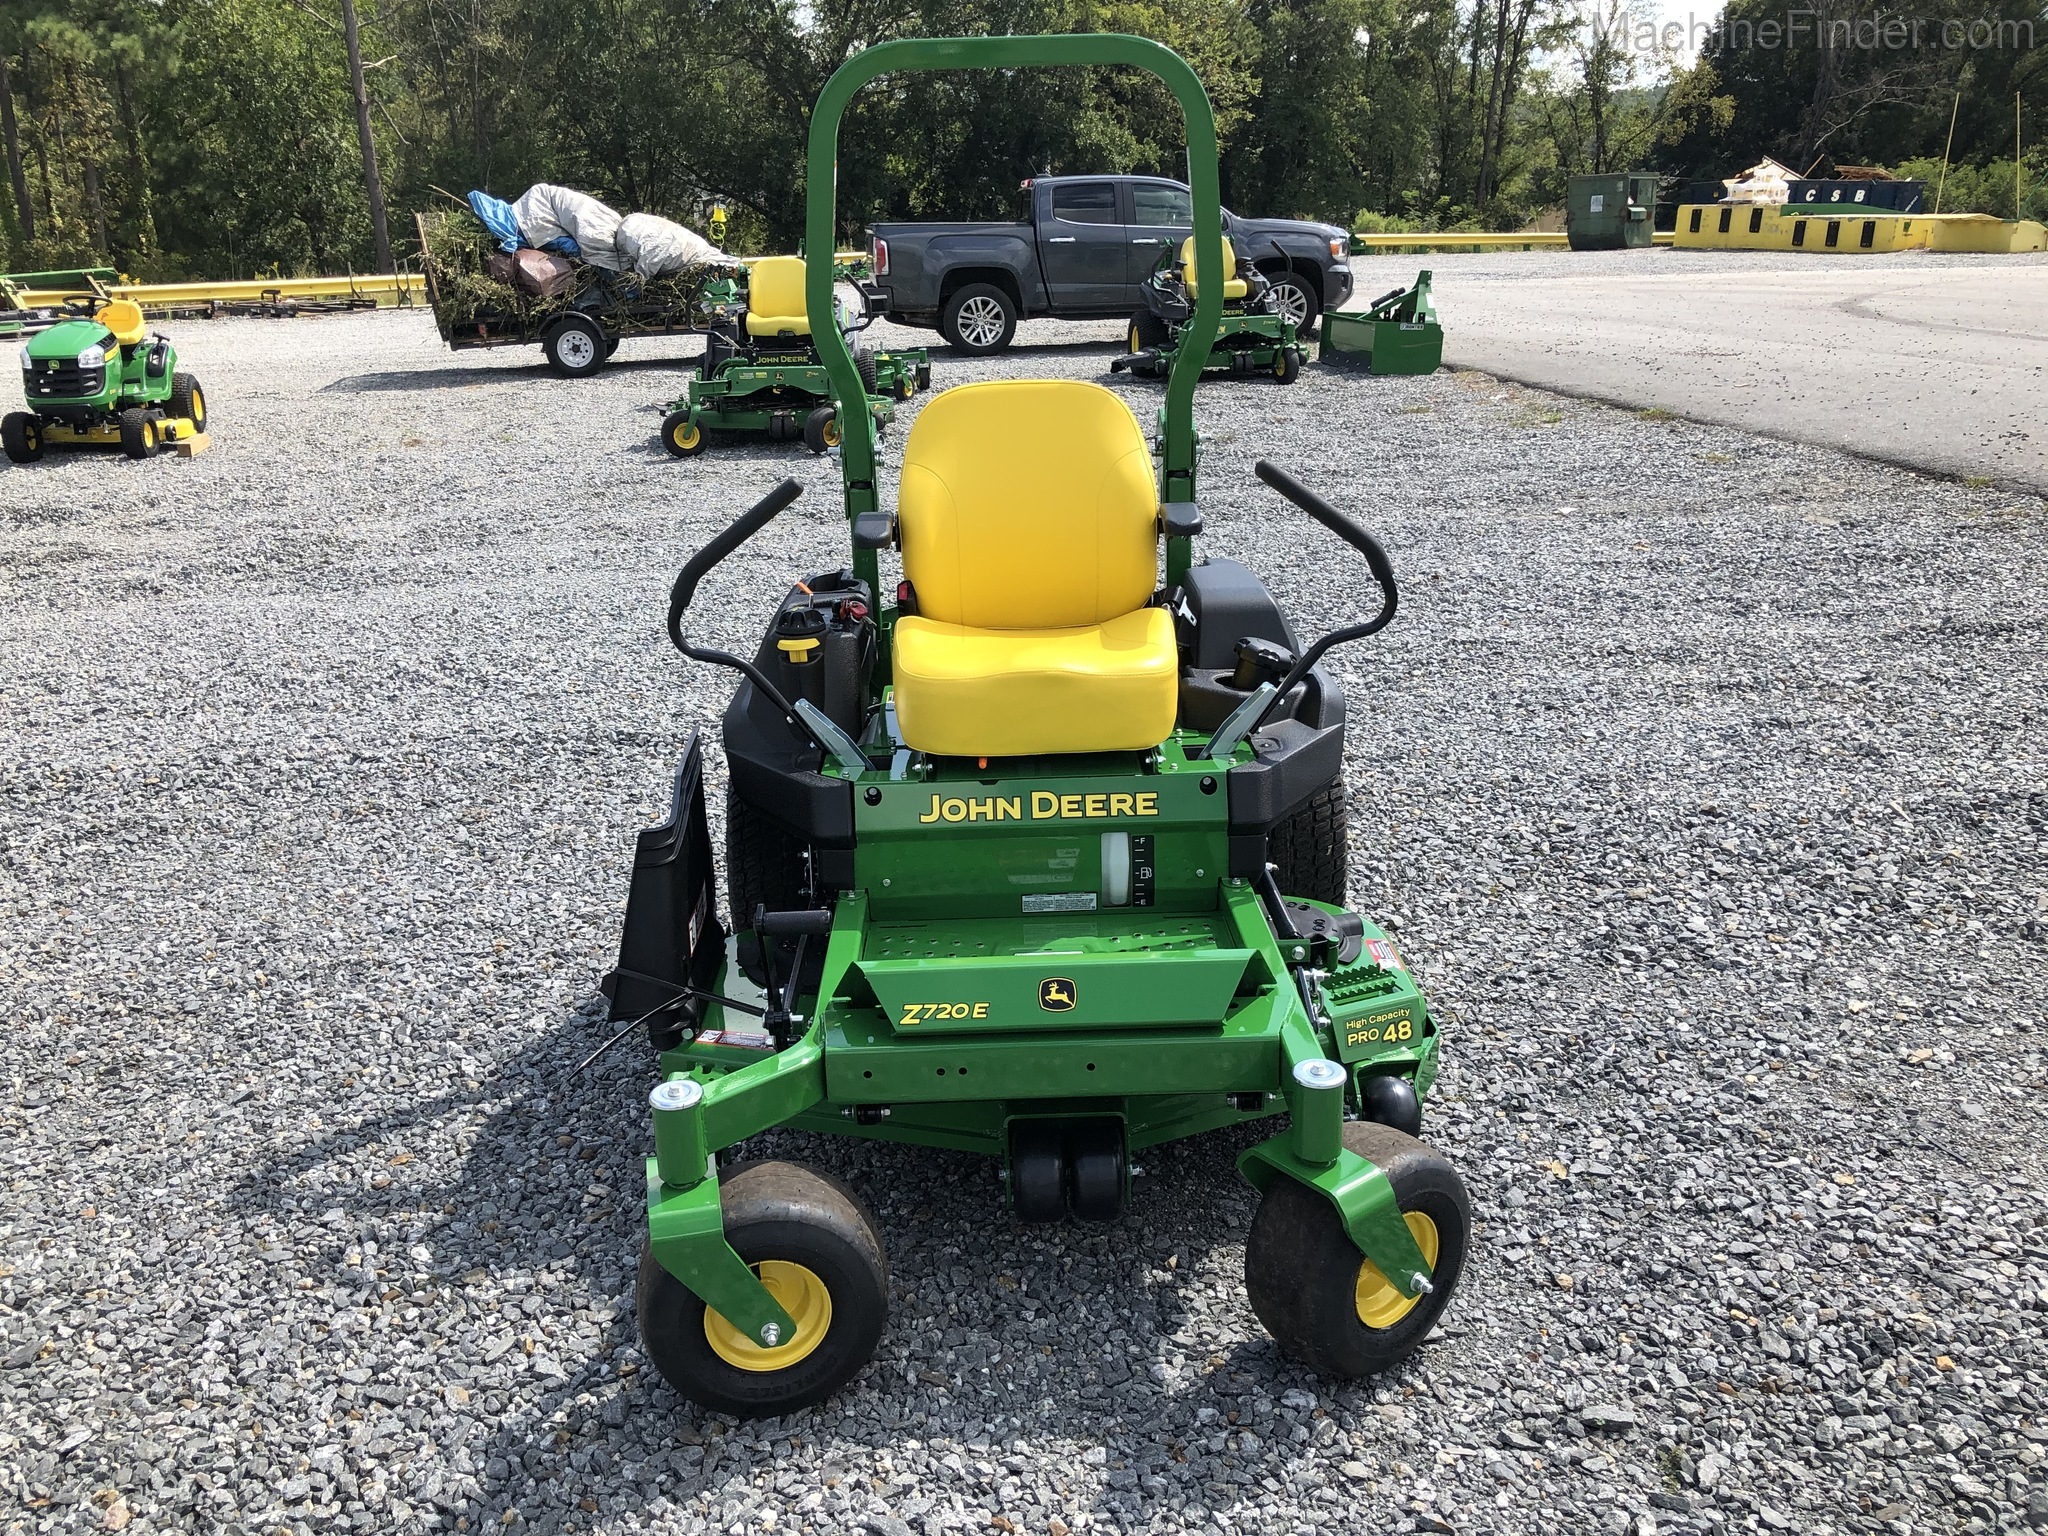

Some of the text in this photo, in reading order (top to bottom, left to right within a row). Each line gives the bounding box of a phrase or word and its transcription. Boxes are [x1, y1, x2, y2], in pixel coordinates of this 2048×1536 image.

[756, 355, 809, 364] JOHN DEERE
[919, 790, 1159, 823] JOHN DEERE
[1346, 1008, 1411, 1030] High Capacity
[1347, 1019, 1413, 1047] PRO 48
